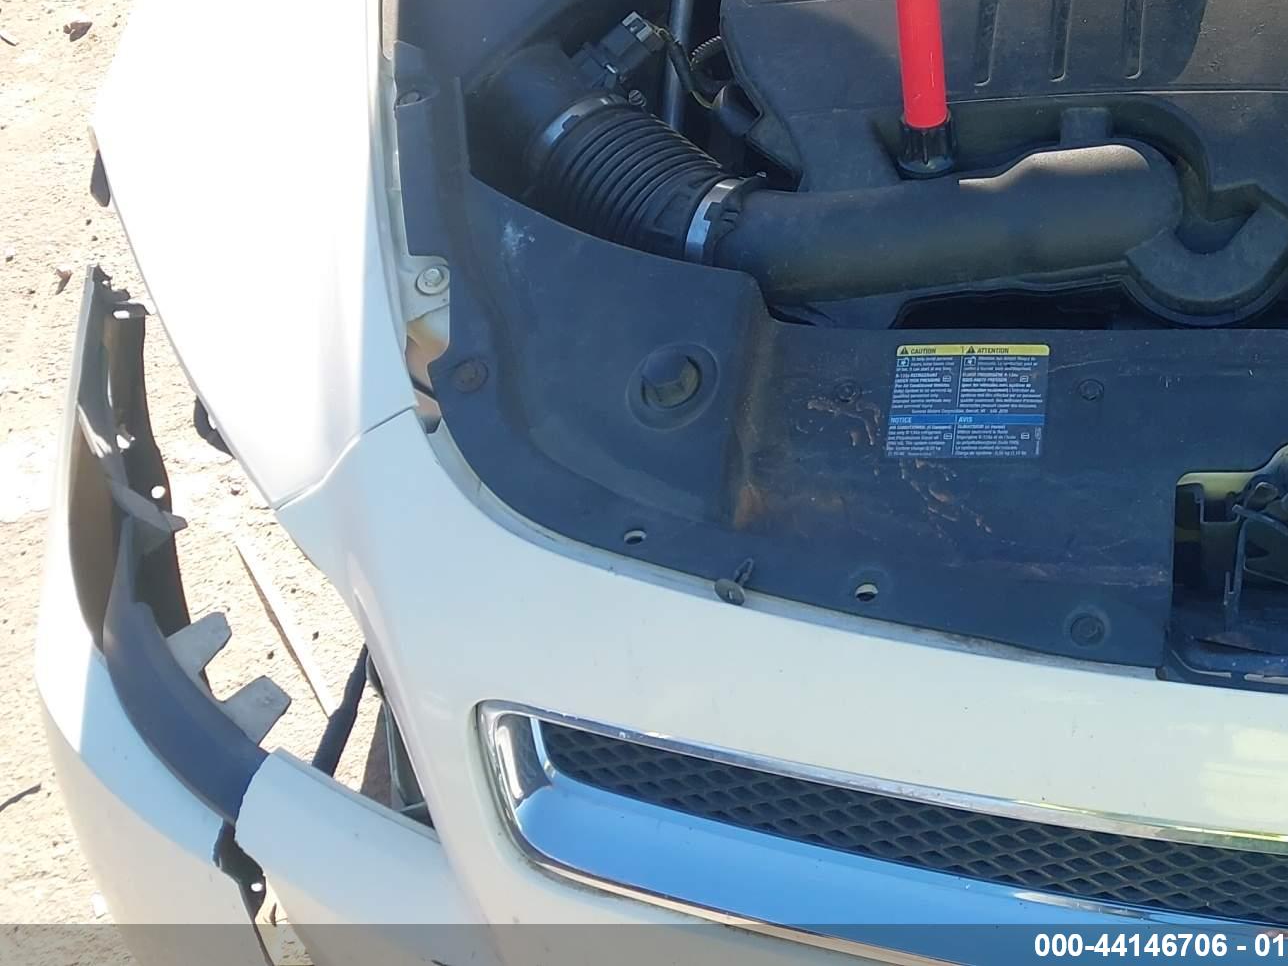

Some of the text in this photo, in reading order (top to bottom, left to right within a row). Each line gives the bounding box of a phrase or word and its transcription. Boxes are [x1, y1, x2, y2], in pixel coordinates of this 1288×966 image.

[910, 347, 937, 355] CAUTION
[977, 347, 1010, 355] ATTENTION
[890, 416, 912, 424] NOTICE
